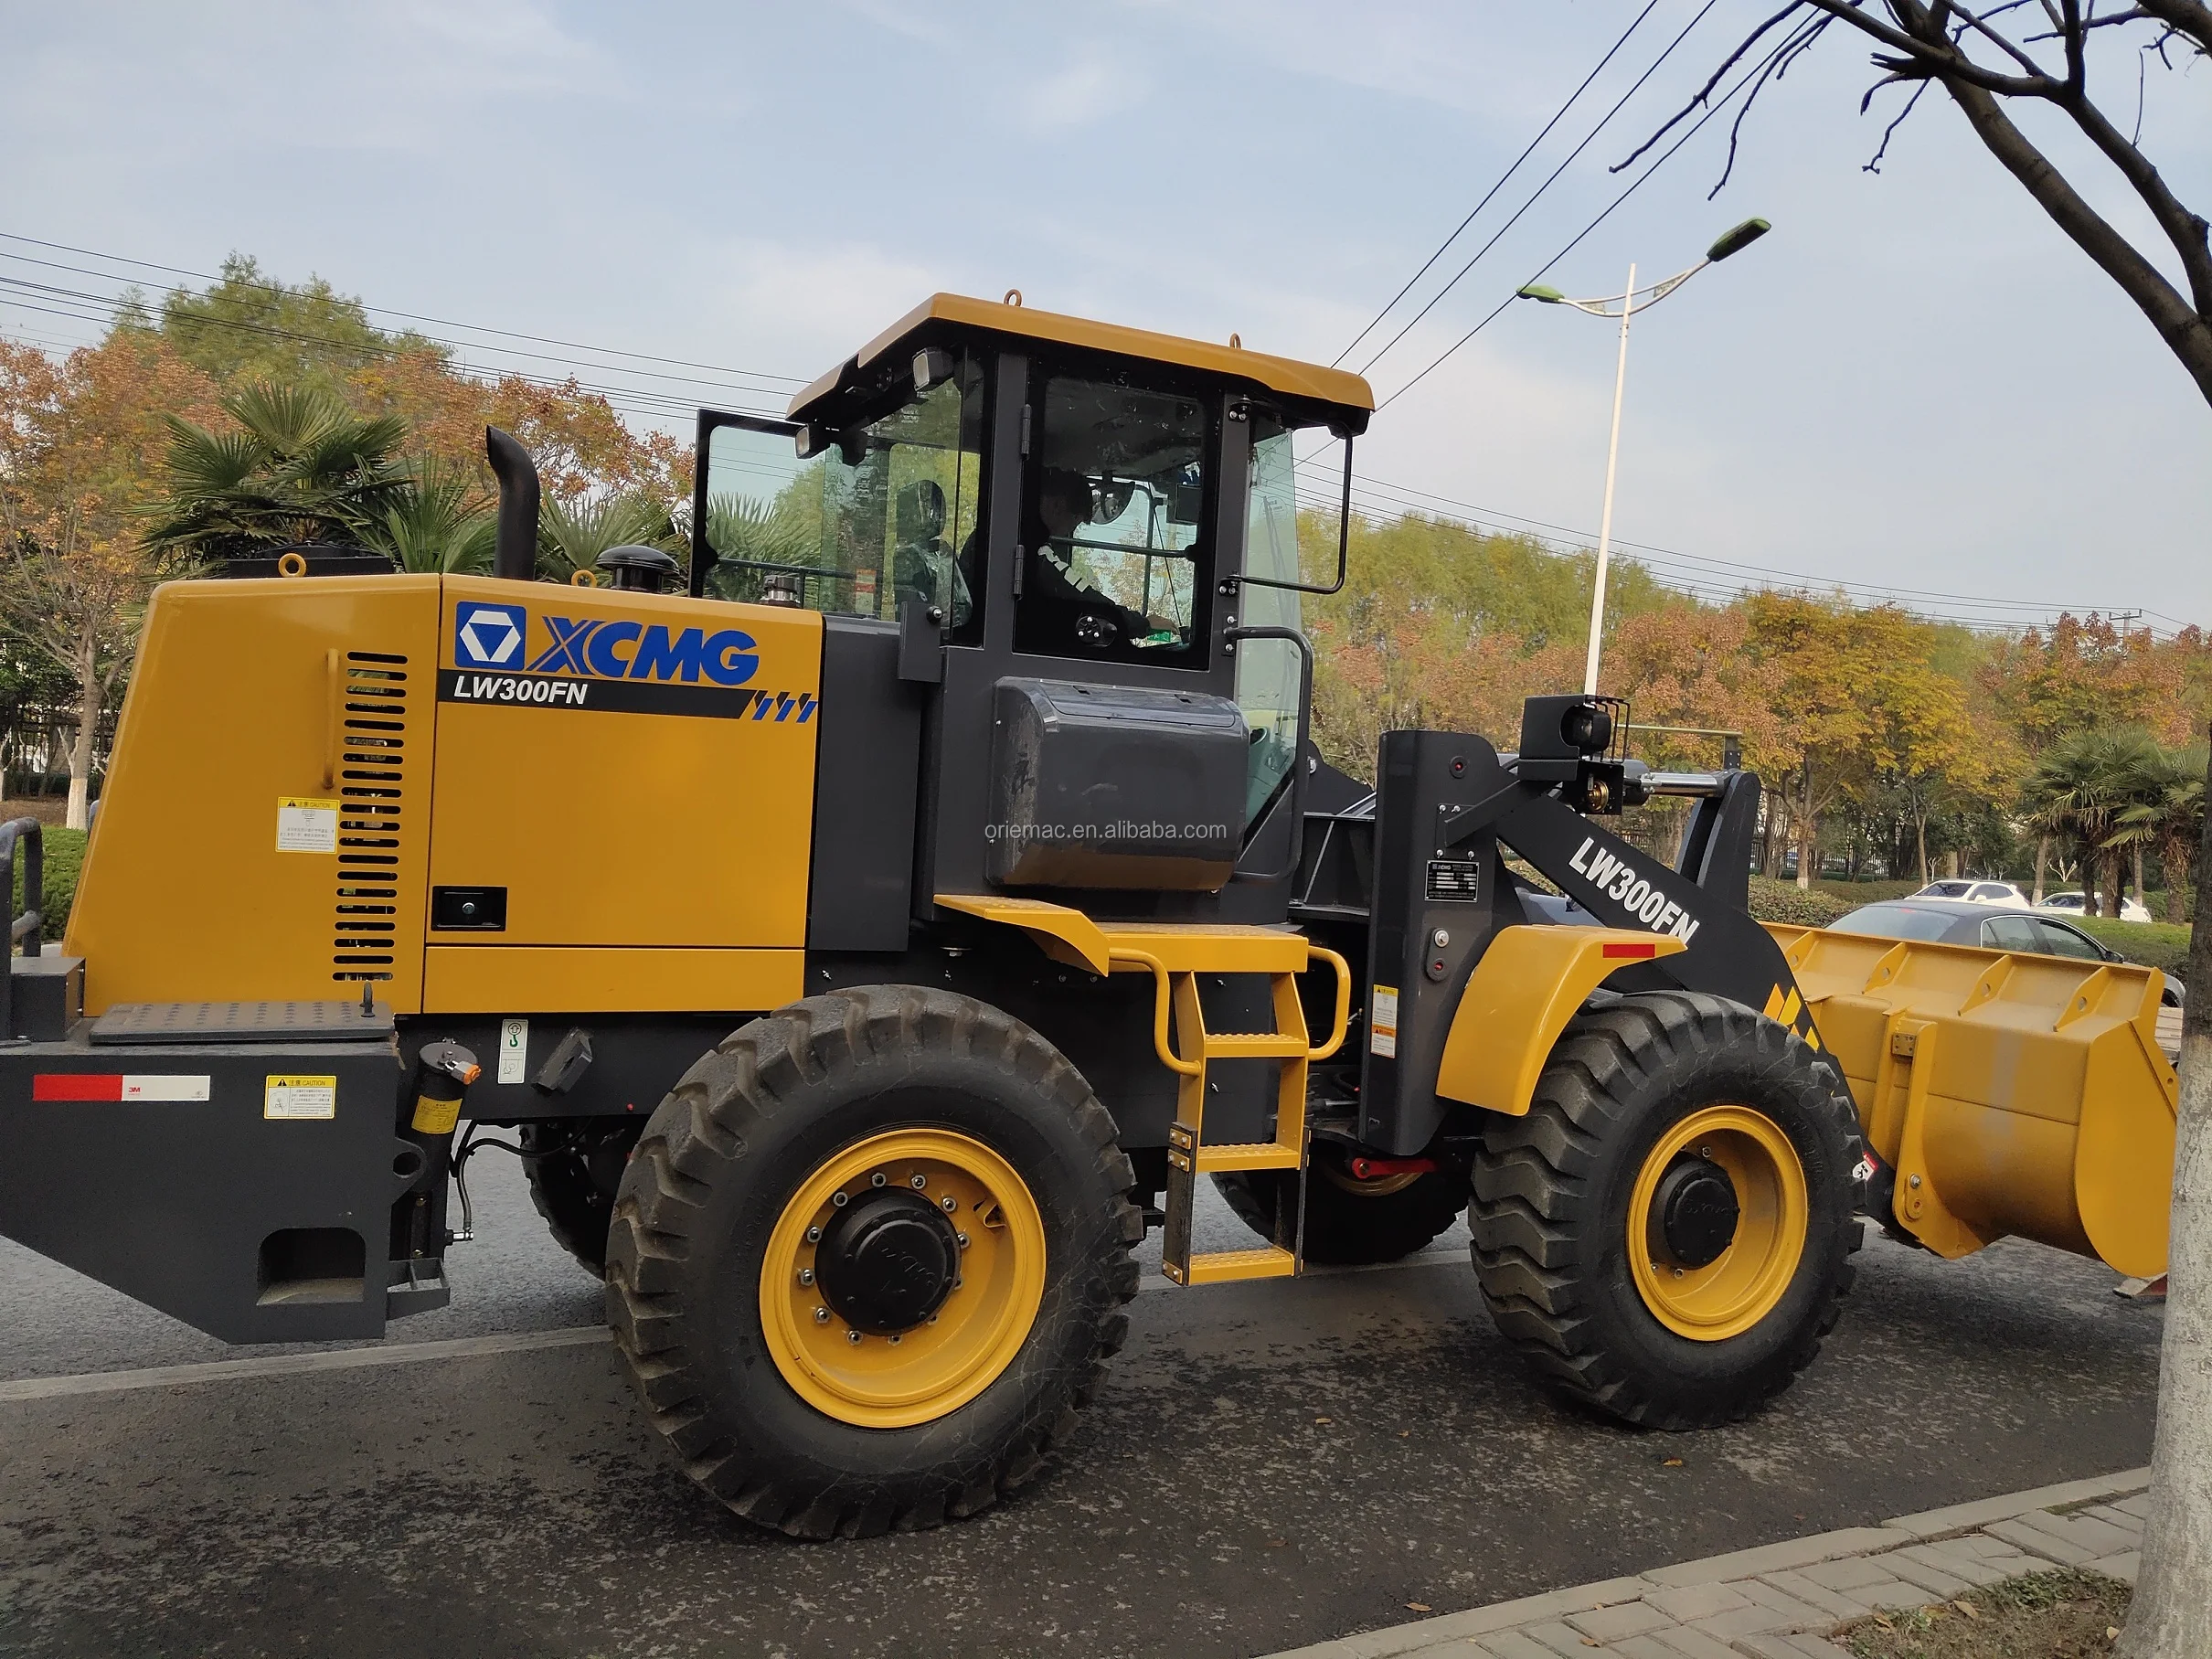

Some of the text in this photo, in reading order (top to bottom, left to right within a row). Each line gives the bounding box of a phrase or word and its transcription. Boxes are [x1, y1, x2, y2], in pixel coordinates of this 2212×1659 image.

[526, 616, 760, 686] XCMG
[453, 675, 588, 705] LW300FN
[1569, 836, 1700, 945] LW300FN
